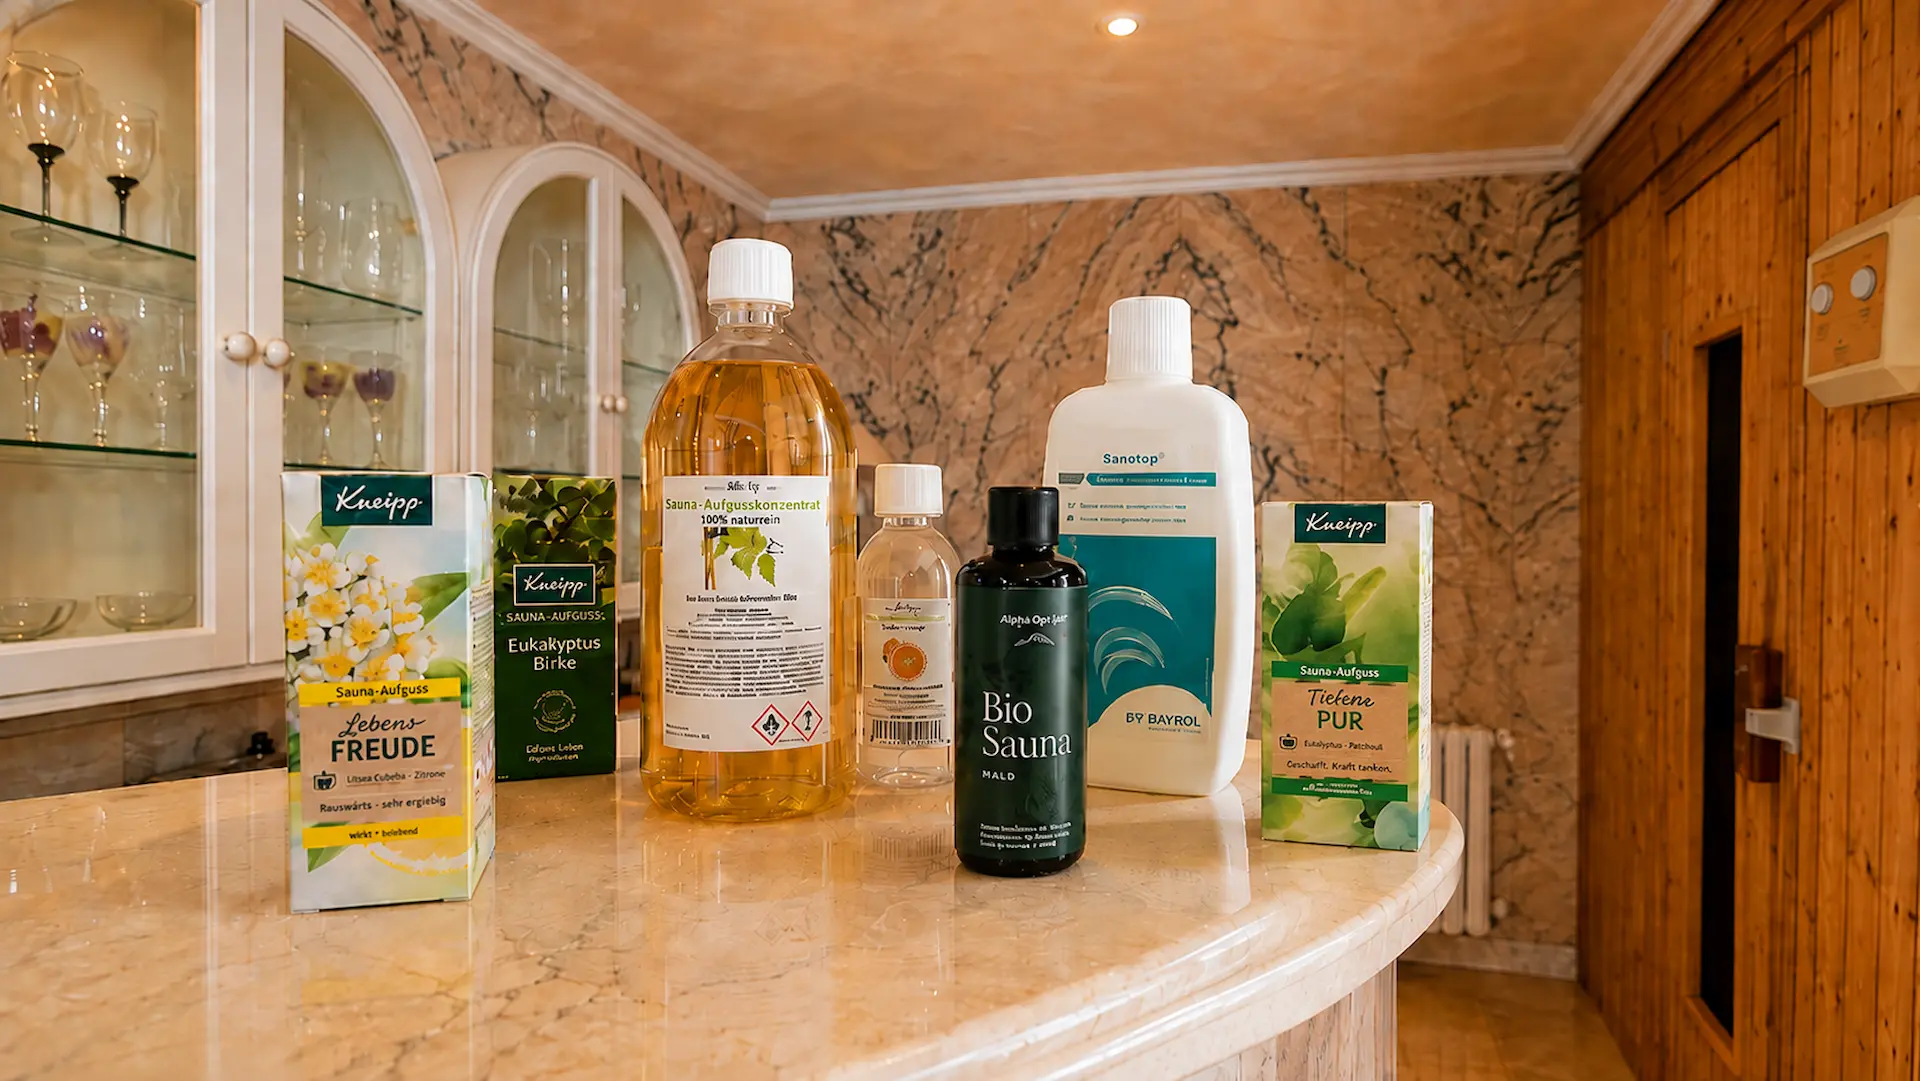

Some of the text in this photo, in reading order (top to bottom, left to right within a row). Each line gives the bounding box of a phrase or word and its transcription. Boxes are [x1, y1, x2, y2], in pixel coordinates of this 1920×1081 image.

[1102, 452, 1159, 466] Sanotop
[335, 484, 422, 520] Kneipp
[701, 514, 781, 525] 100% naturrein
[1305, 511, 1376, 539] Kneipp
[523, 571, 587, 598] Kneipp
[533, 656, 577, 671] Birke
[336, 683, 429, 699] Sauna-Aufguss
[982, 690, 1033, 725] Bio
[337, 712, 427, 738] Lebens
[1148, 713, 1201, 727] BAYROL
[1317, 710, 1364, 731] PUR
[331, 735, 436, 763] FREUDE
[982, 725, 1072, 759] Sauna
[982, 769, 1016, 781] MALD
[381, 798, 404, 809] sehr
[406, 794, 447, 809] ergiebig
